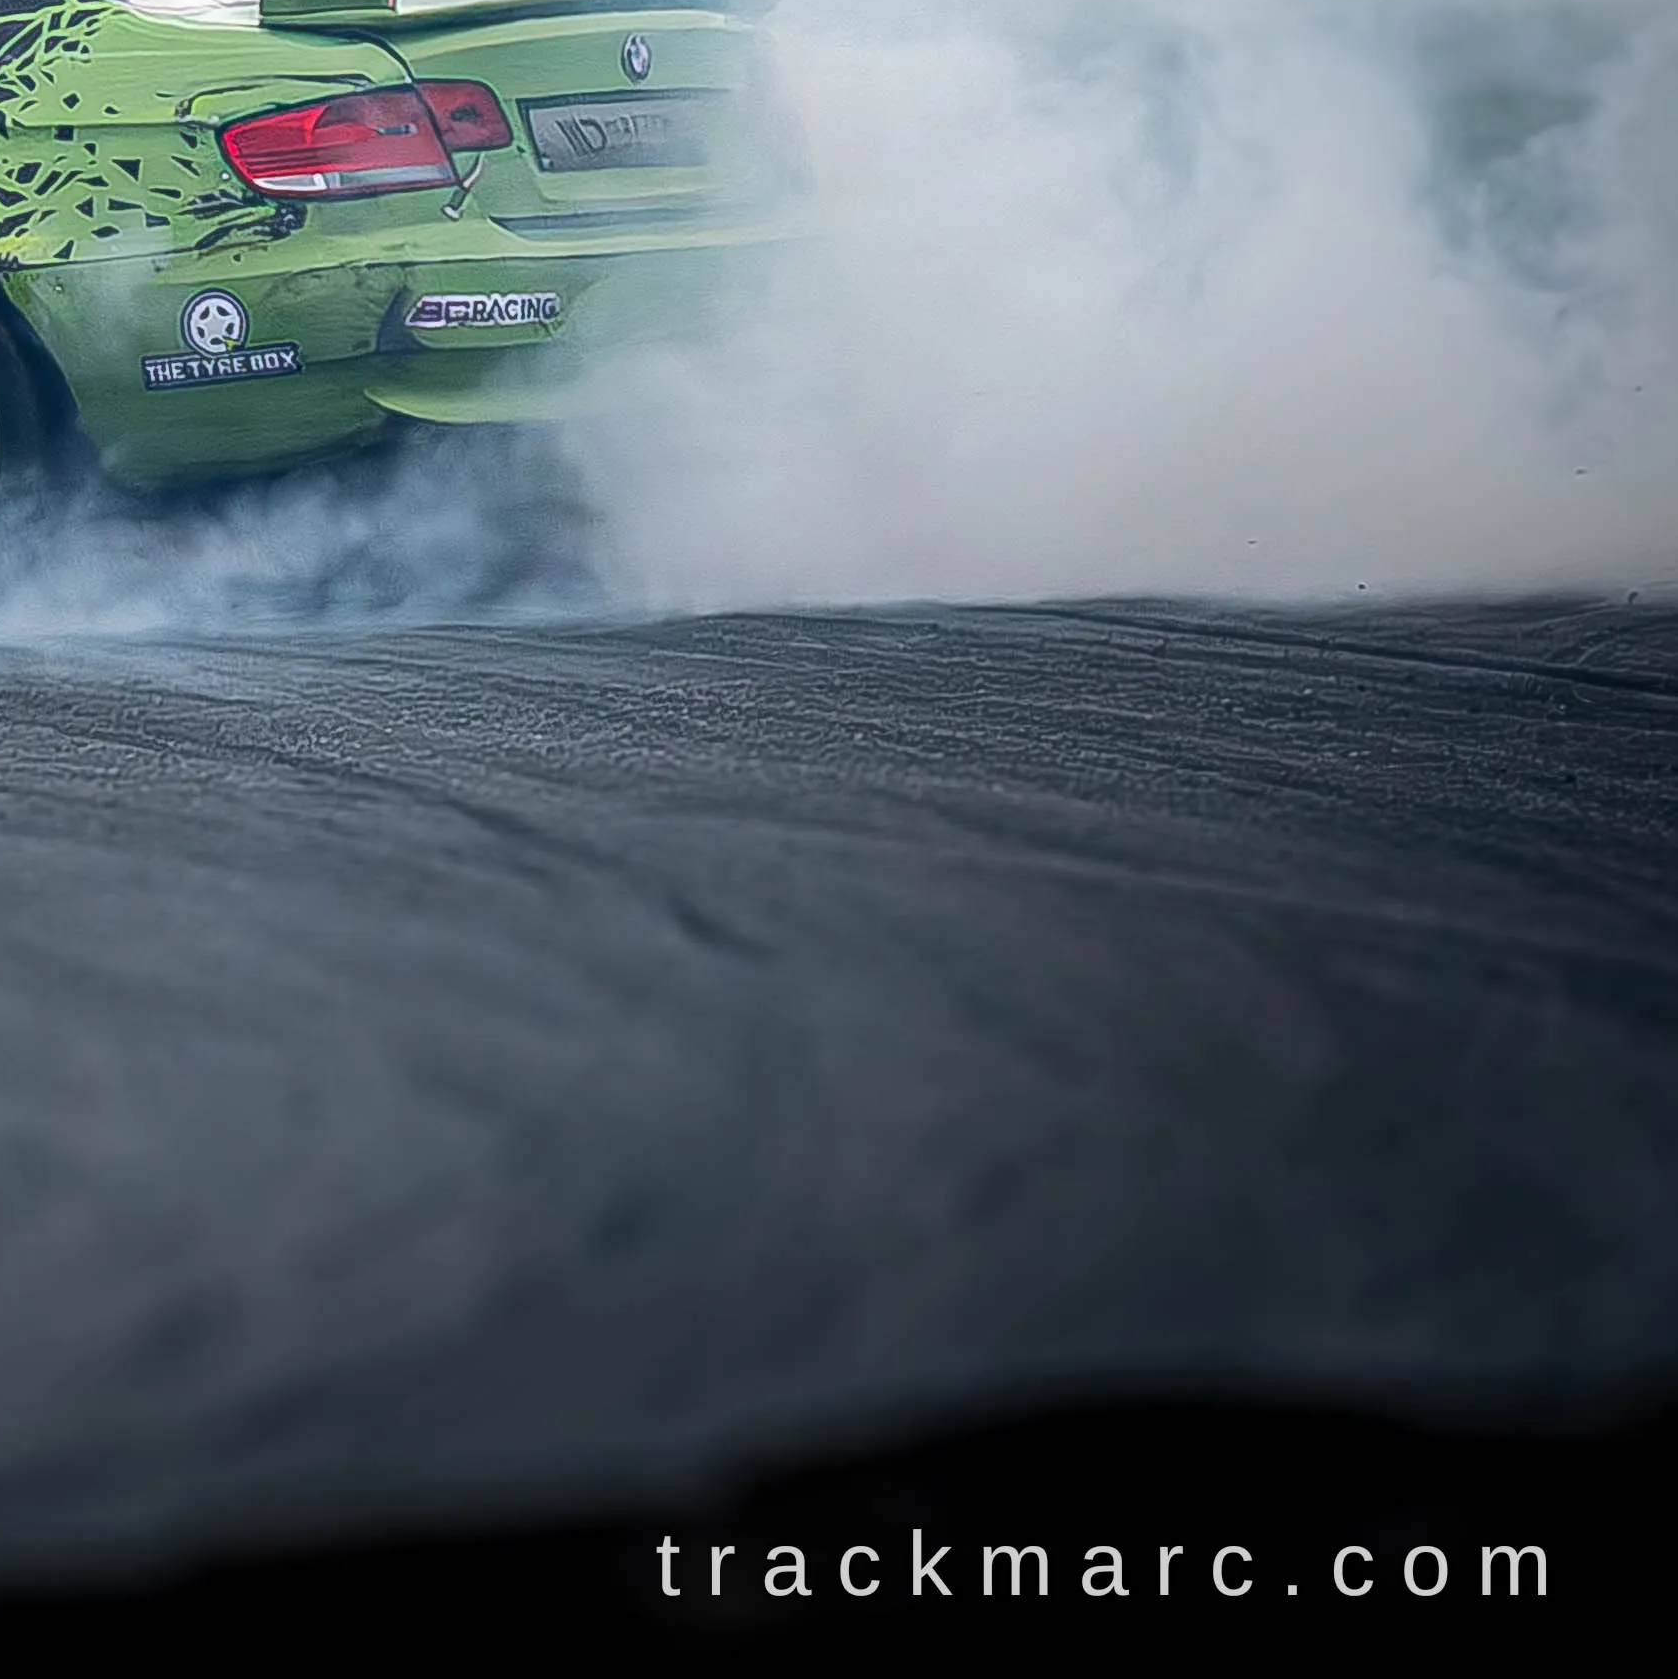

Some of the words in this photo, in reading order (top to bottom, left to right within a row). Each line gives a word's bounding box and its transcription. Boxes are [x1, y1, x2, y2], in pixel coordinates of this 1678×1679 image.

[145, 363, 186, 382] THE
[187, 355, 247, 377] TYRE
[250, 351, 297, 371] BOX
